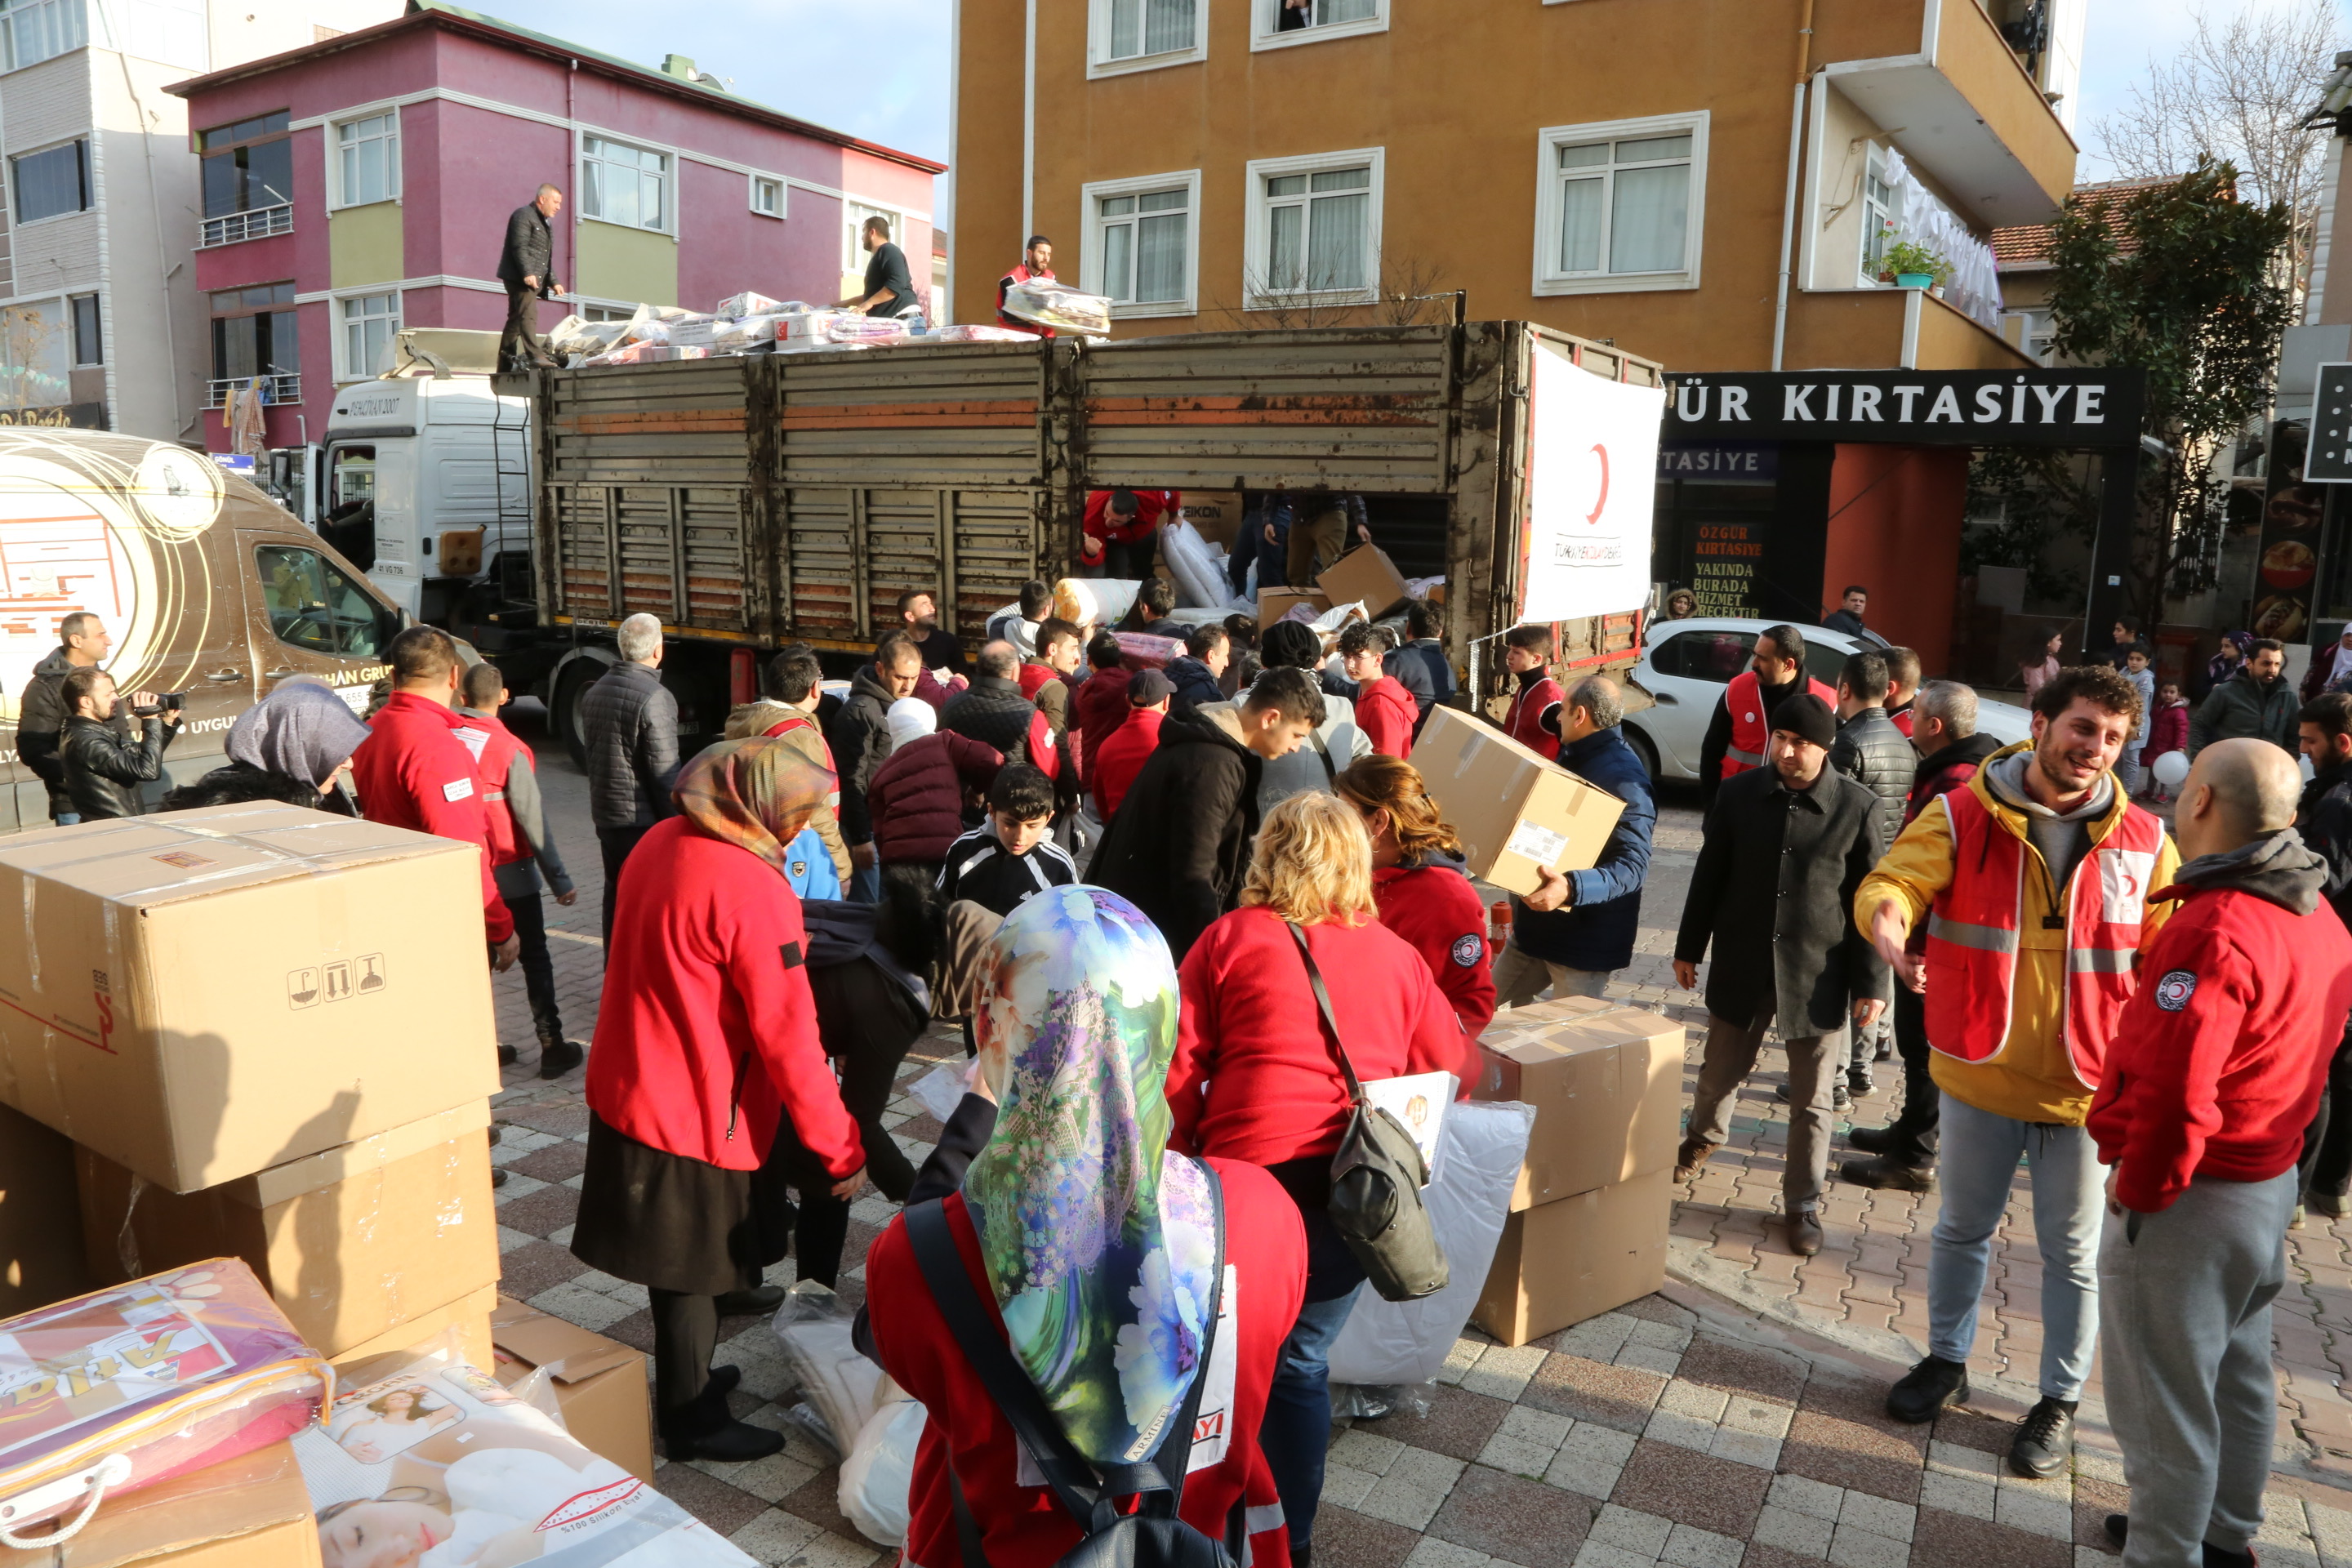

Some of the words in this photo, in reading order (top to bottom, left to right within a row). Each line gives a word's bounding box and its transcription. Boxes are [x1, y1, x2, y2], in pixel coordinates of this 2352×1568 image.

[1661, 378, 1752, 422] ÜR
[1782, 375, 2106, 424] KIRTASİYE
[214, 455, 235, 464] GÖNÜL
[1657, 448, 1758, 471] TASİYE
[1181, 506, 1221, 518] EIKON
[1695, 563, 1753, 577] YAKINDA
[1693, 578, 1749, 593] BURADA
[1696, 604, 1759, 619] RECEKTİR
[320, 669, 358, 686] HAN
[345, 693, 363, 703] 655
[560, 1519, 587, 1534] %100
[588, 1503, 622, 1525] Silikon
